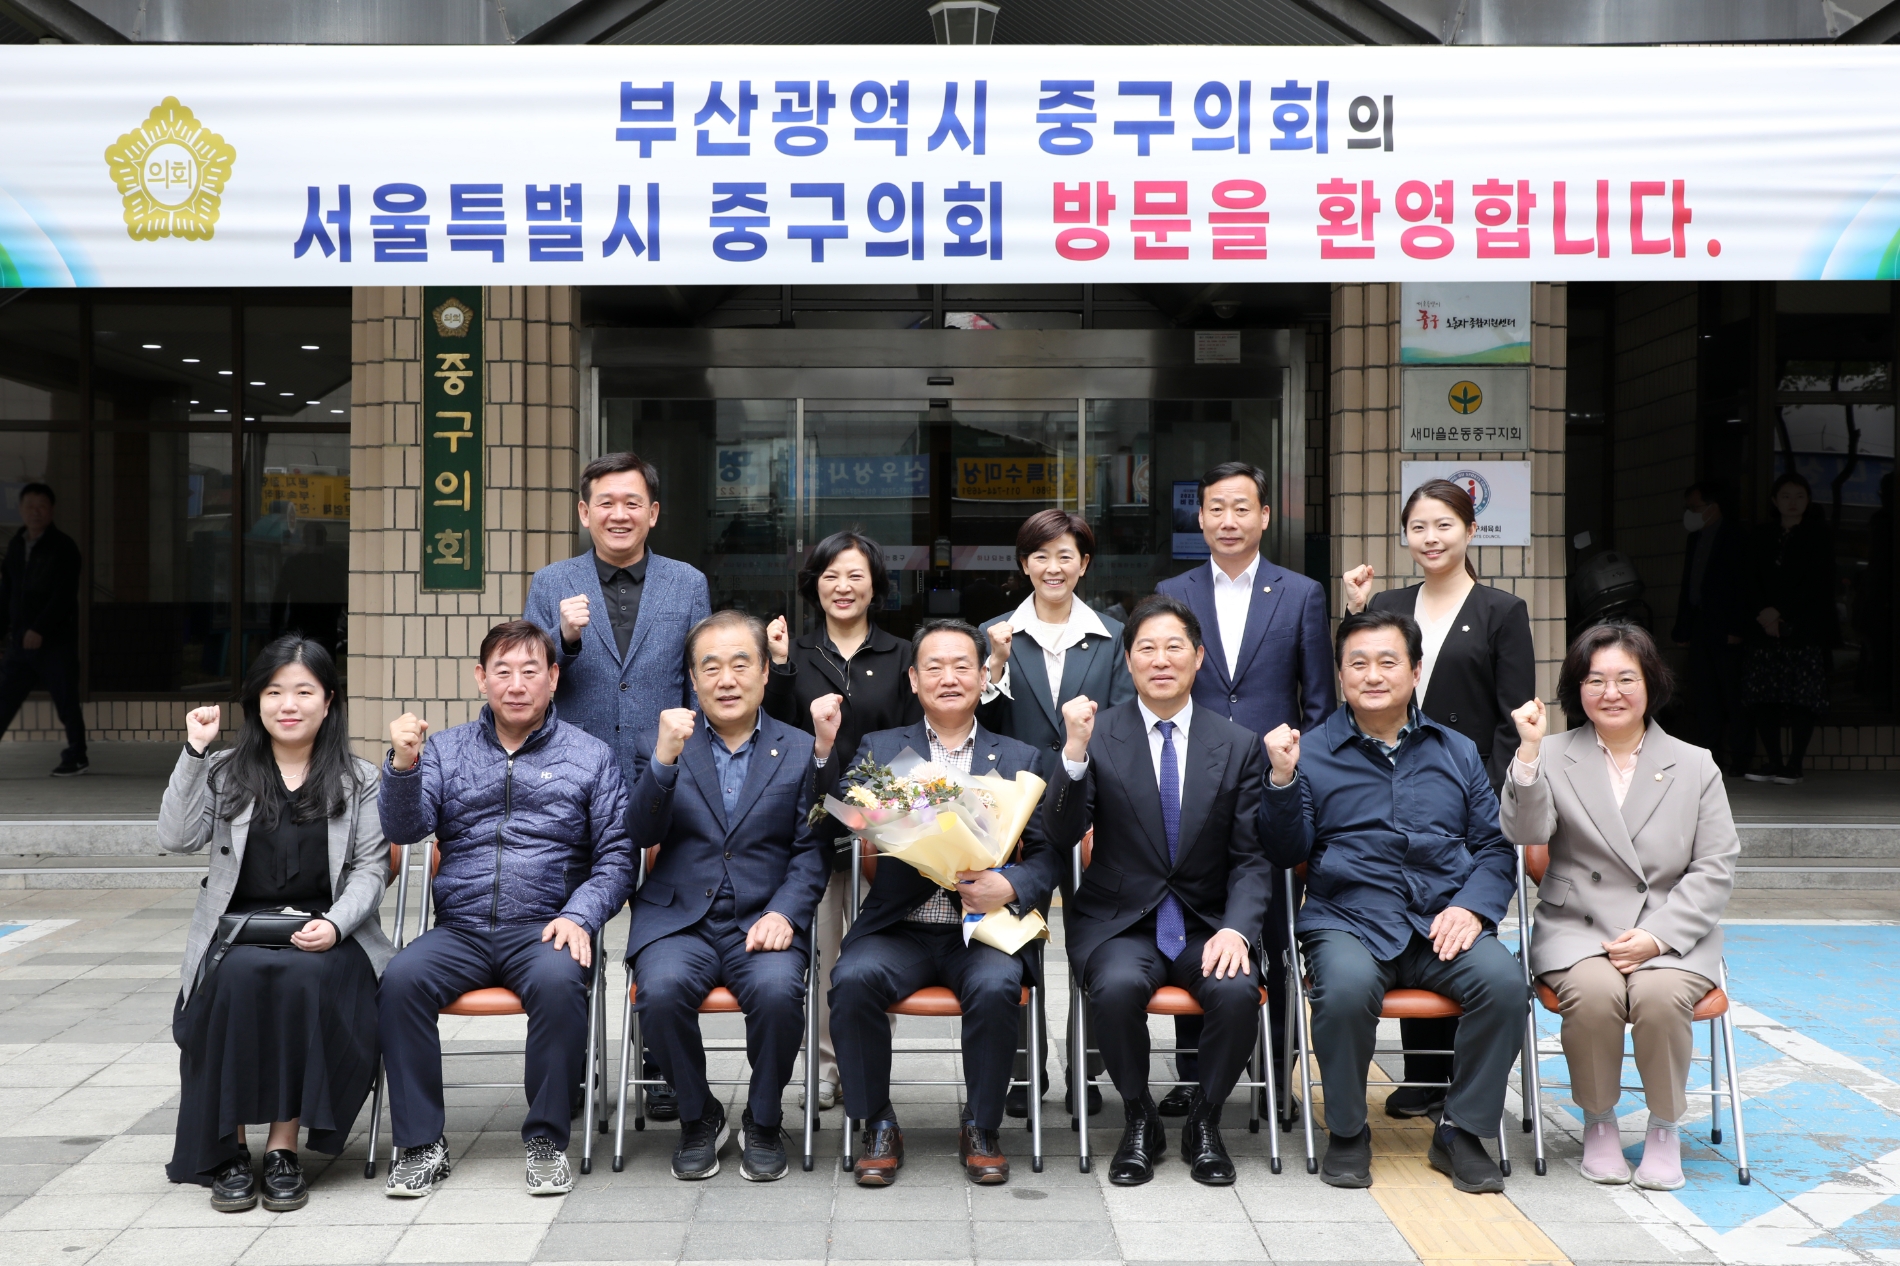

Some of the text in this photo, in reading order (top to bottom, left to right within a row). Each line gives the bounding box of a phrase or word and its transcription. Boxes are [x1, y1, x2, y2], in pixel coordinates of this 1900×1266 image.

[617, 81, 1393, 157] 부산광역시 중구의회의
[146, 157, 194, 191] 의회
[295, 178, 1721, 262] 서울특별시 중구의회 방문을 환영합니다.
[444, 313, 462, 323] 의회
[1416, 309, 1439, 330] 중구
[1410, 427, 1522, 441] 새마을운동중구지회
[433, 353, 474, 571] 중구의회
